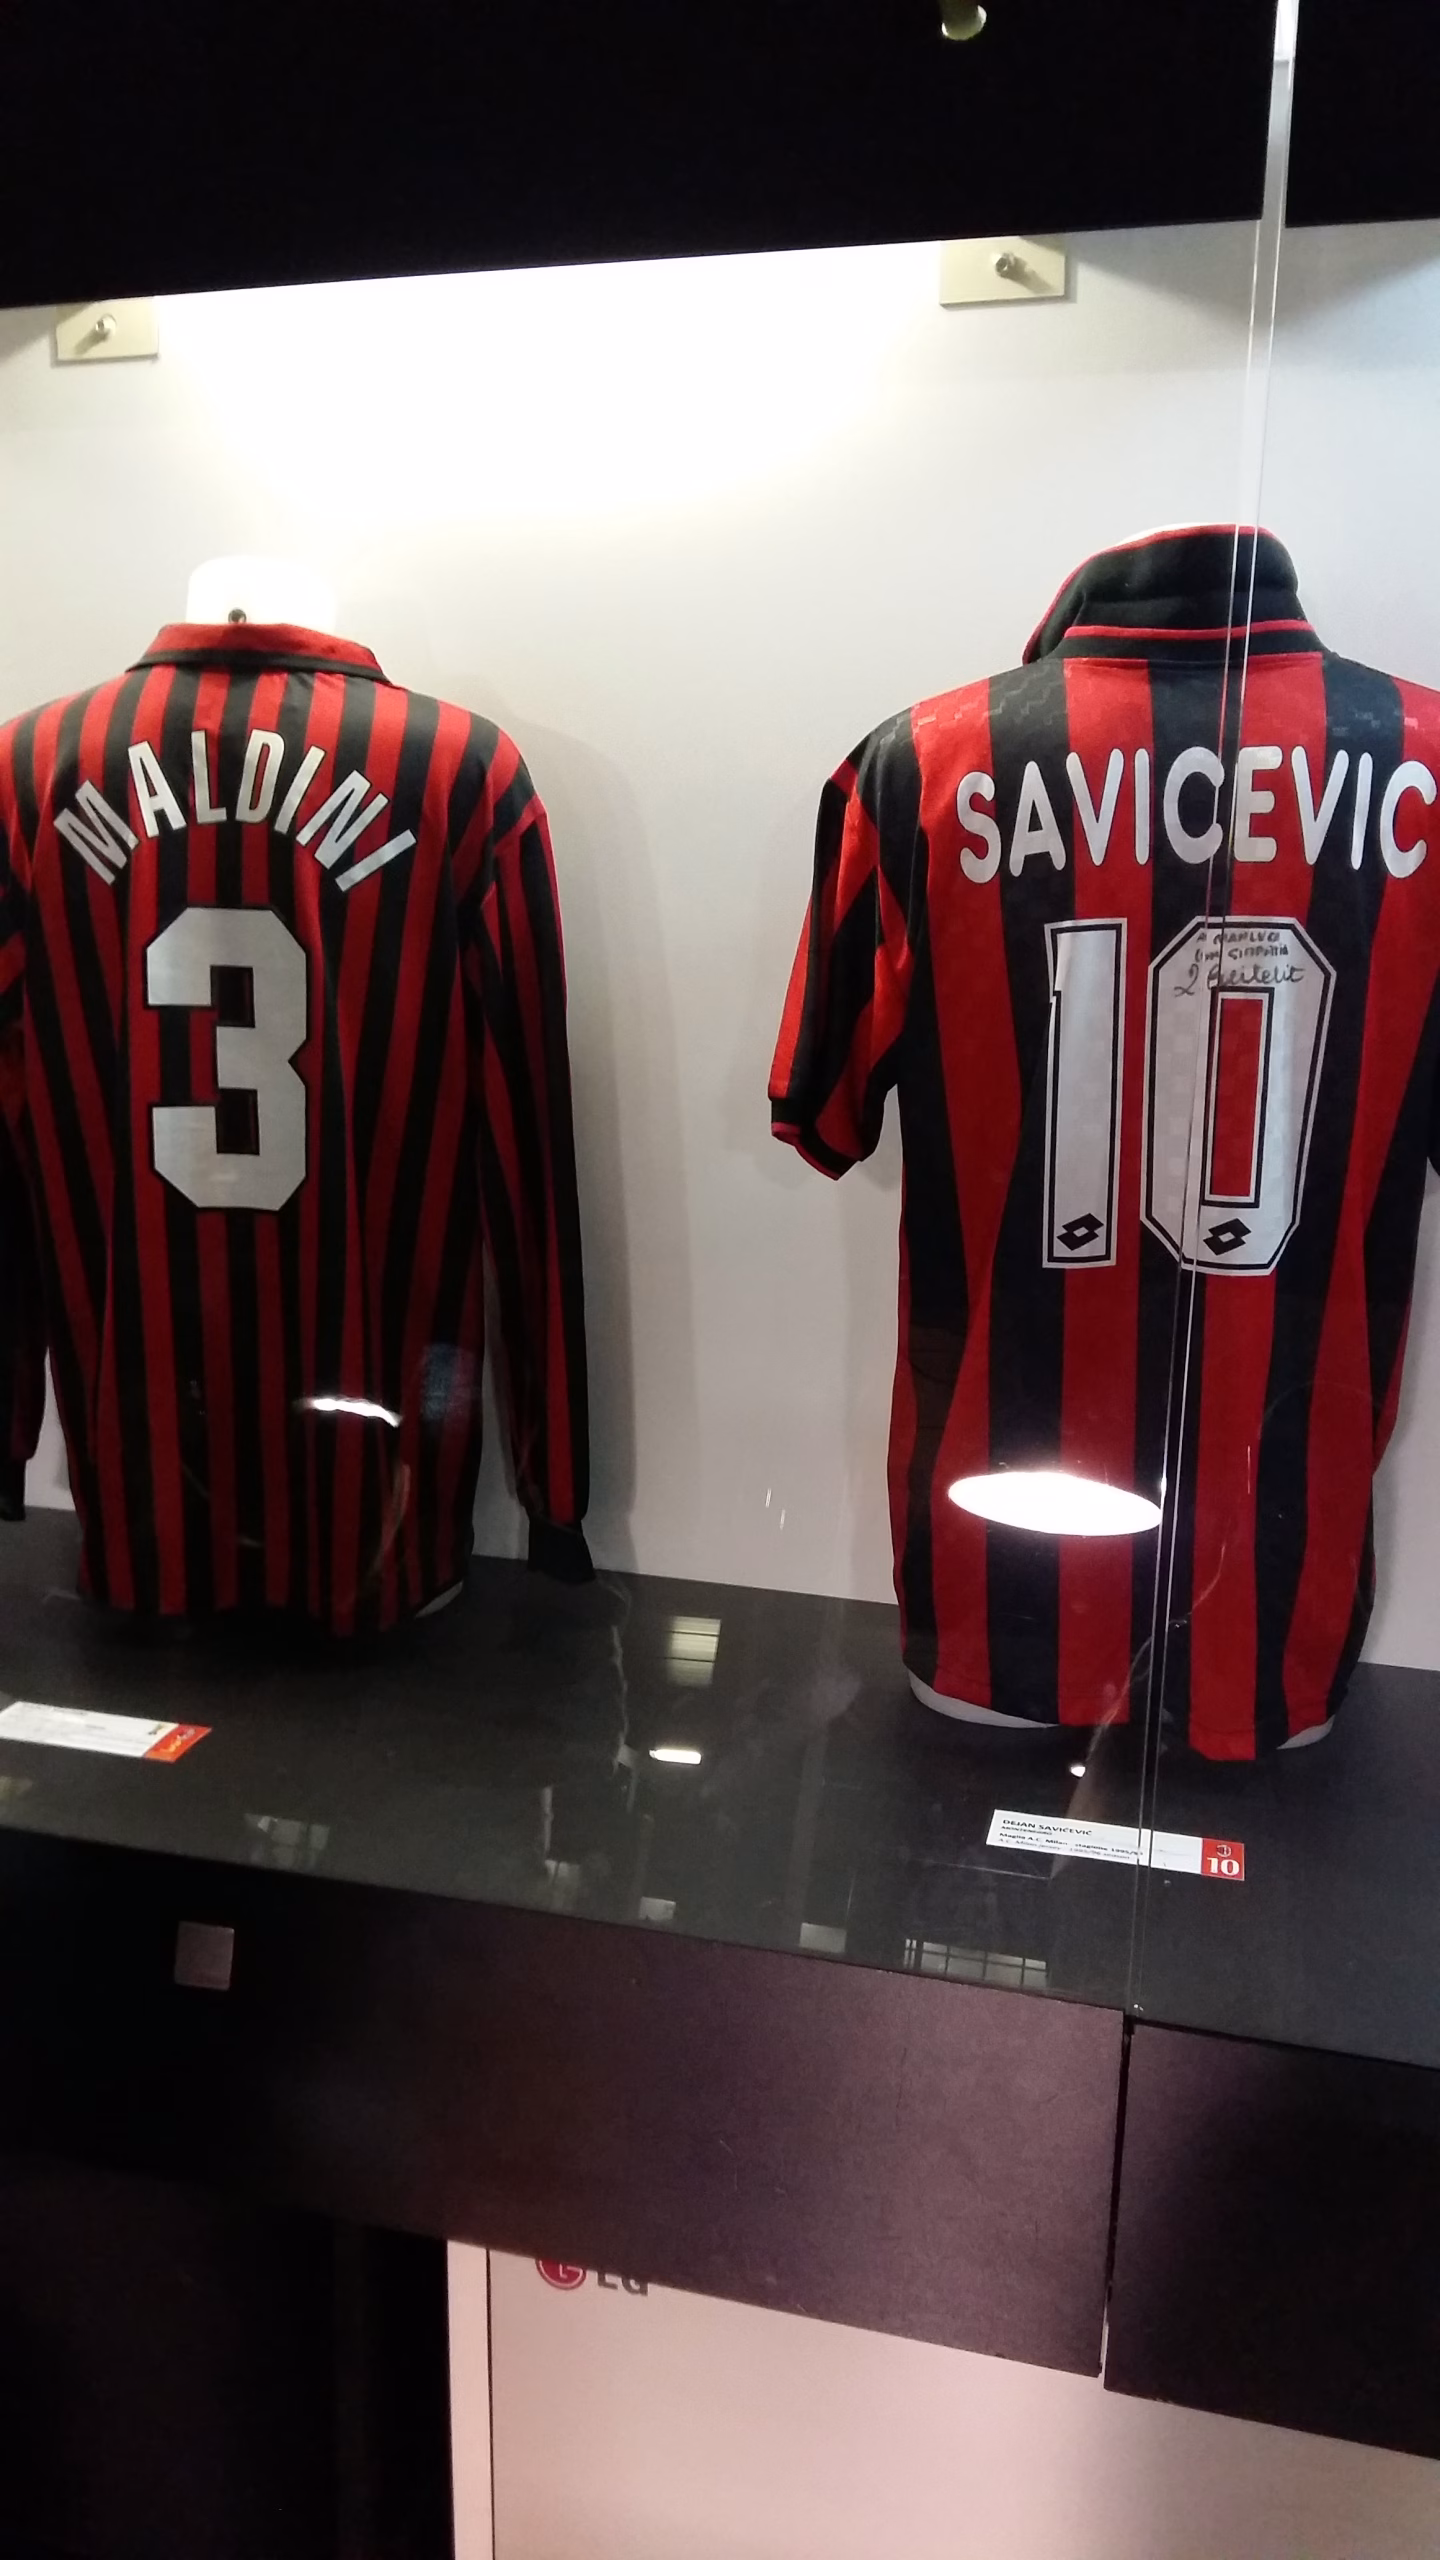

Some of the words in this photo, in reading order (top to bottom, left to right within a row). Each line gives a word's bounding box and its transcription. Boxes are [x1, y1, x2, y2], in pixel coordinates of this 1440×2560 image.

[53, 728, 417, 892] MALDINI
[956, 745, 1438, 885] SAVICEVIC
[146, 906, 307, 1212] 3
[1042, 915, 1337, 1276] 10
[999, 1832, 1026, 1840] Maglia
[1002, 1819, 1036, 1829] DEJAN
[1206, 1857, 1241, 1876] 10
